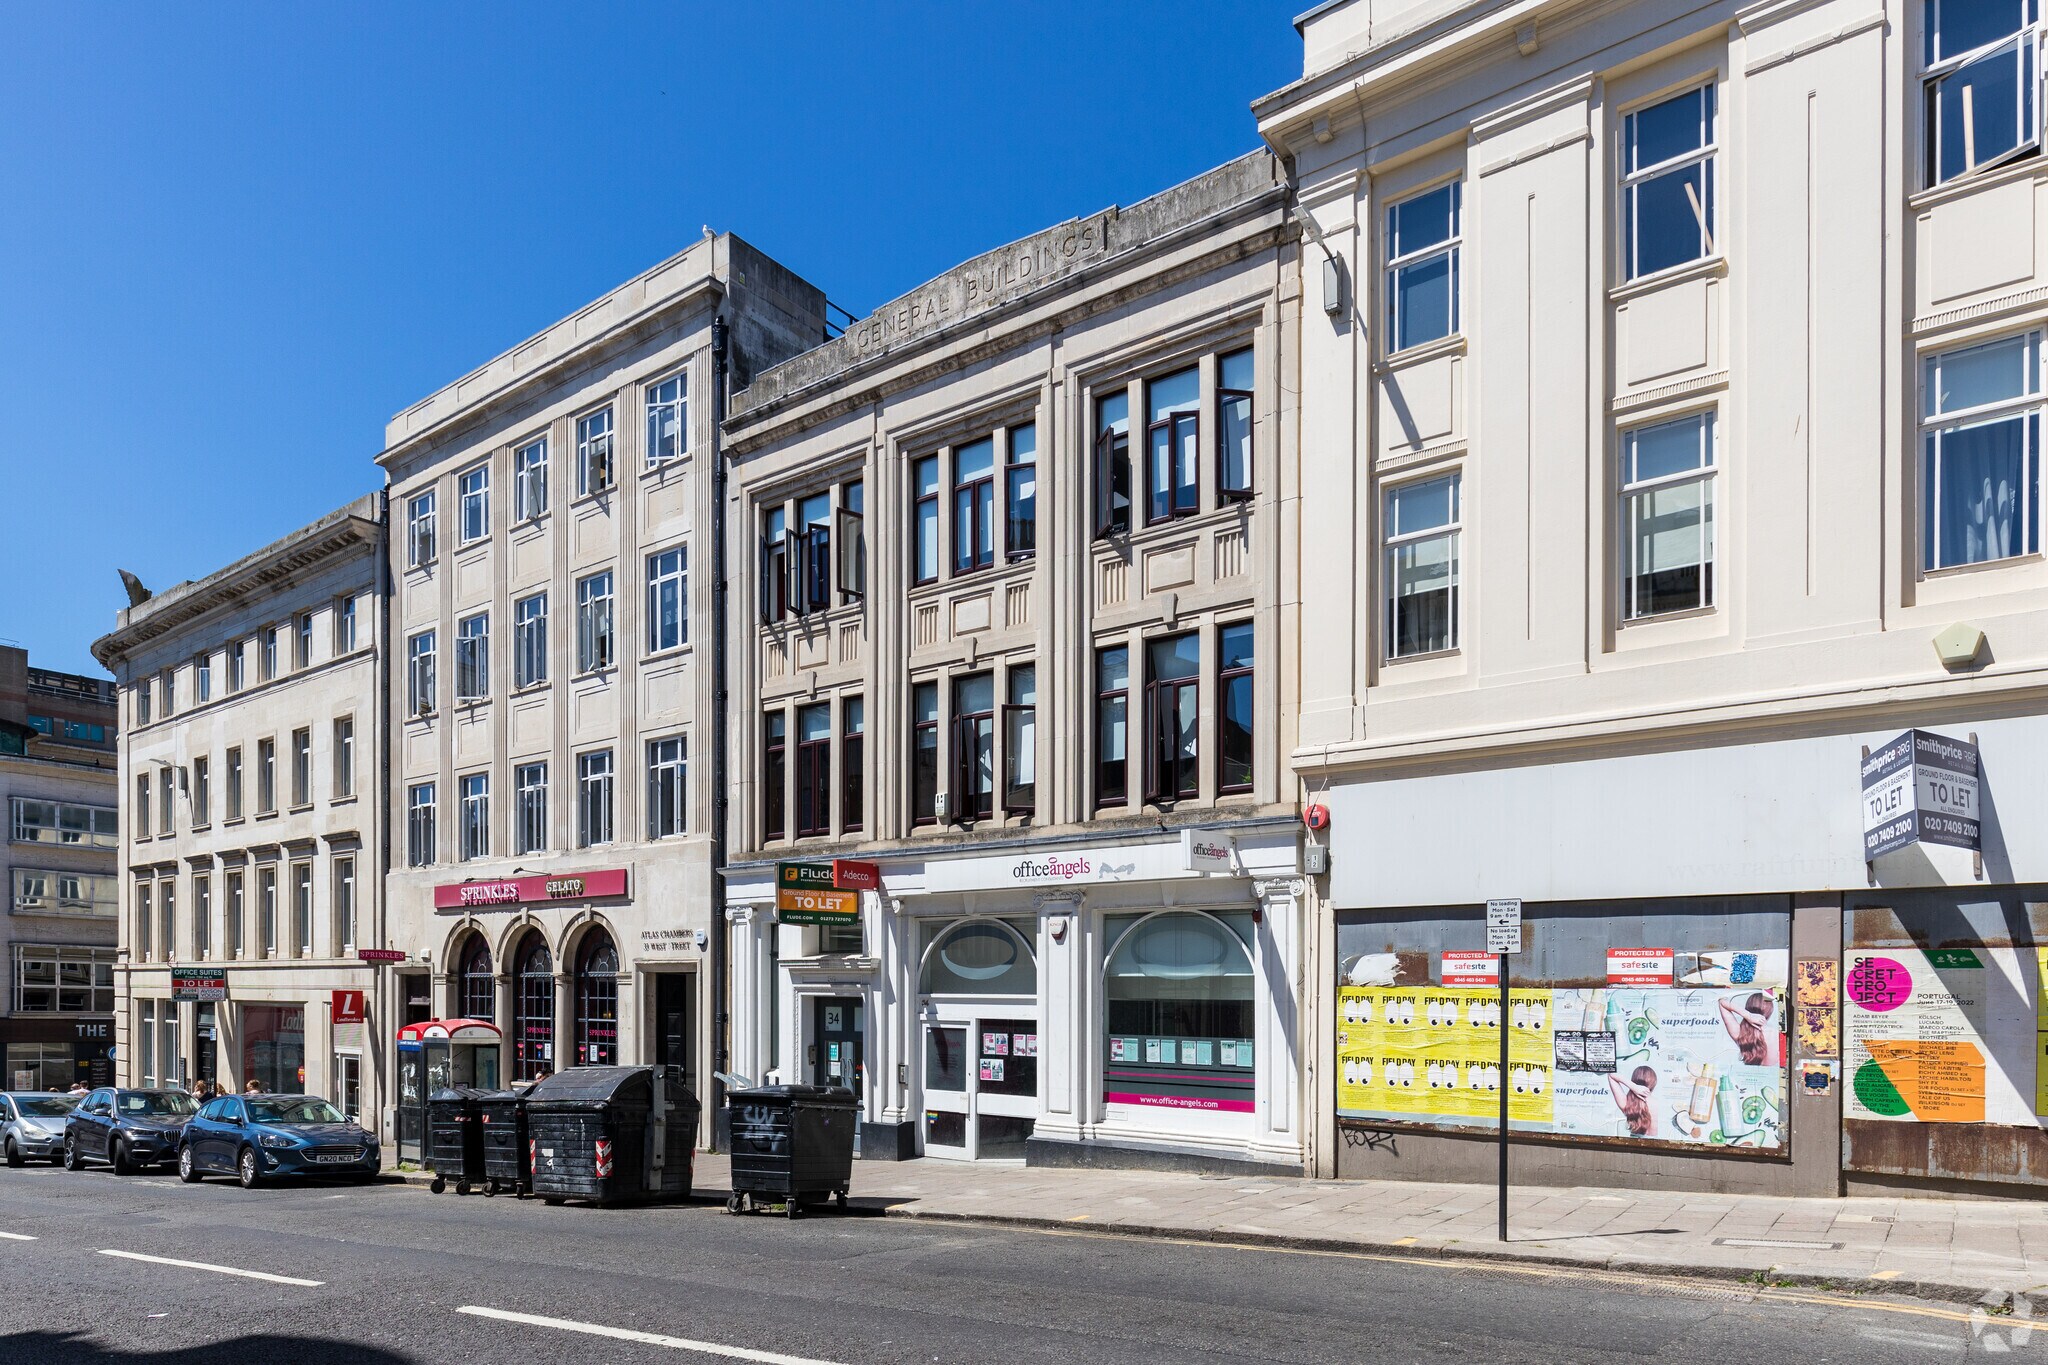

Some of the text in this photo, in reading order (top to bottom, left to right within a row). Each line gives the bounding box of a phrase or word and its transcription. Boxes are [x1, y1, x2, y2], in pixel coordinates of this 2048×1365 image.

[856, 228, 1092, 348] GENERAL BUILDINGS
[1917, 739, 1962, 760] smithprice
[1862, 750, 1896, 778] smithprice
[1918, 768, 1938, 779] GROUND
[1940, 772, 1954, 782] FLOOR
[1930, 782, 1971, 809] TO LET
[1870, 786, 1902, 819] TO LET
[1868, 818, 1912, 848] 020 7409 2100
[1925, 817, 1978, 838] 020 7409 2100
[1193, 843, 1228, 860] officeangels
[1013, 857, 1090, 879] officeangels
[843, 870, 869, 880] Adecco
[460, 880, 580, 900] SPRINKLES GELATO
[795, 897, 842, 910] TO LET
[641, 929, 694, 939] ATLAS CHAMBERS
[650, 943, 667, 951] WEST
[360, 951, 404, 959] SPRINKLES
[1854, 957, 1874, 968] SE
[1854, 969, 1896, 980] CRET
[1854, 980, 1886, 991] PRO
[1383, 996, 1401, 1004] FIELD
[1425, 997, 1444, 1005] FIELD
[1466, 998, 1486, 1006] FIELD
[1510, 999, 1548, 1007] FIELD DAY
[1856, 992, 1896, 1003] JECT
[342, 994, 355, 1014] L
[828, 1013, 839, 1024] 34
[1661, 1018, 1720, 1026] superfoods
[76, 1025, 107, 1036] THE
[1382, 1058, 1401, 1066] FIELD
[1425, 1059, 1459, 1068] FIELD DAY
[1466, 1061, 1486, 1069] FIELD
[1510, 1063, 1548, 1073] FIELD DAY
[1556, 1087, 1608, 1096] superfoods
[1140, 1096, 1218, 1108] www.office-angels.com
